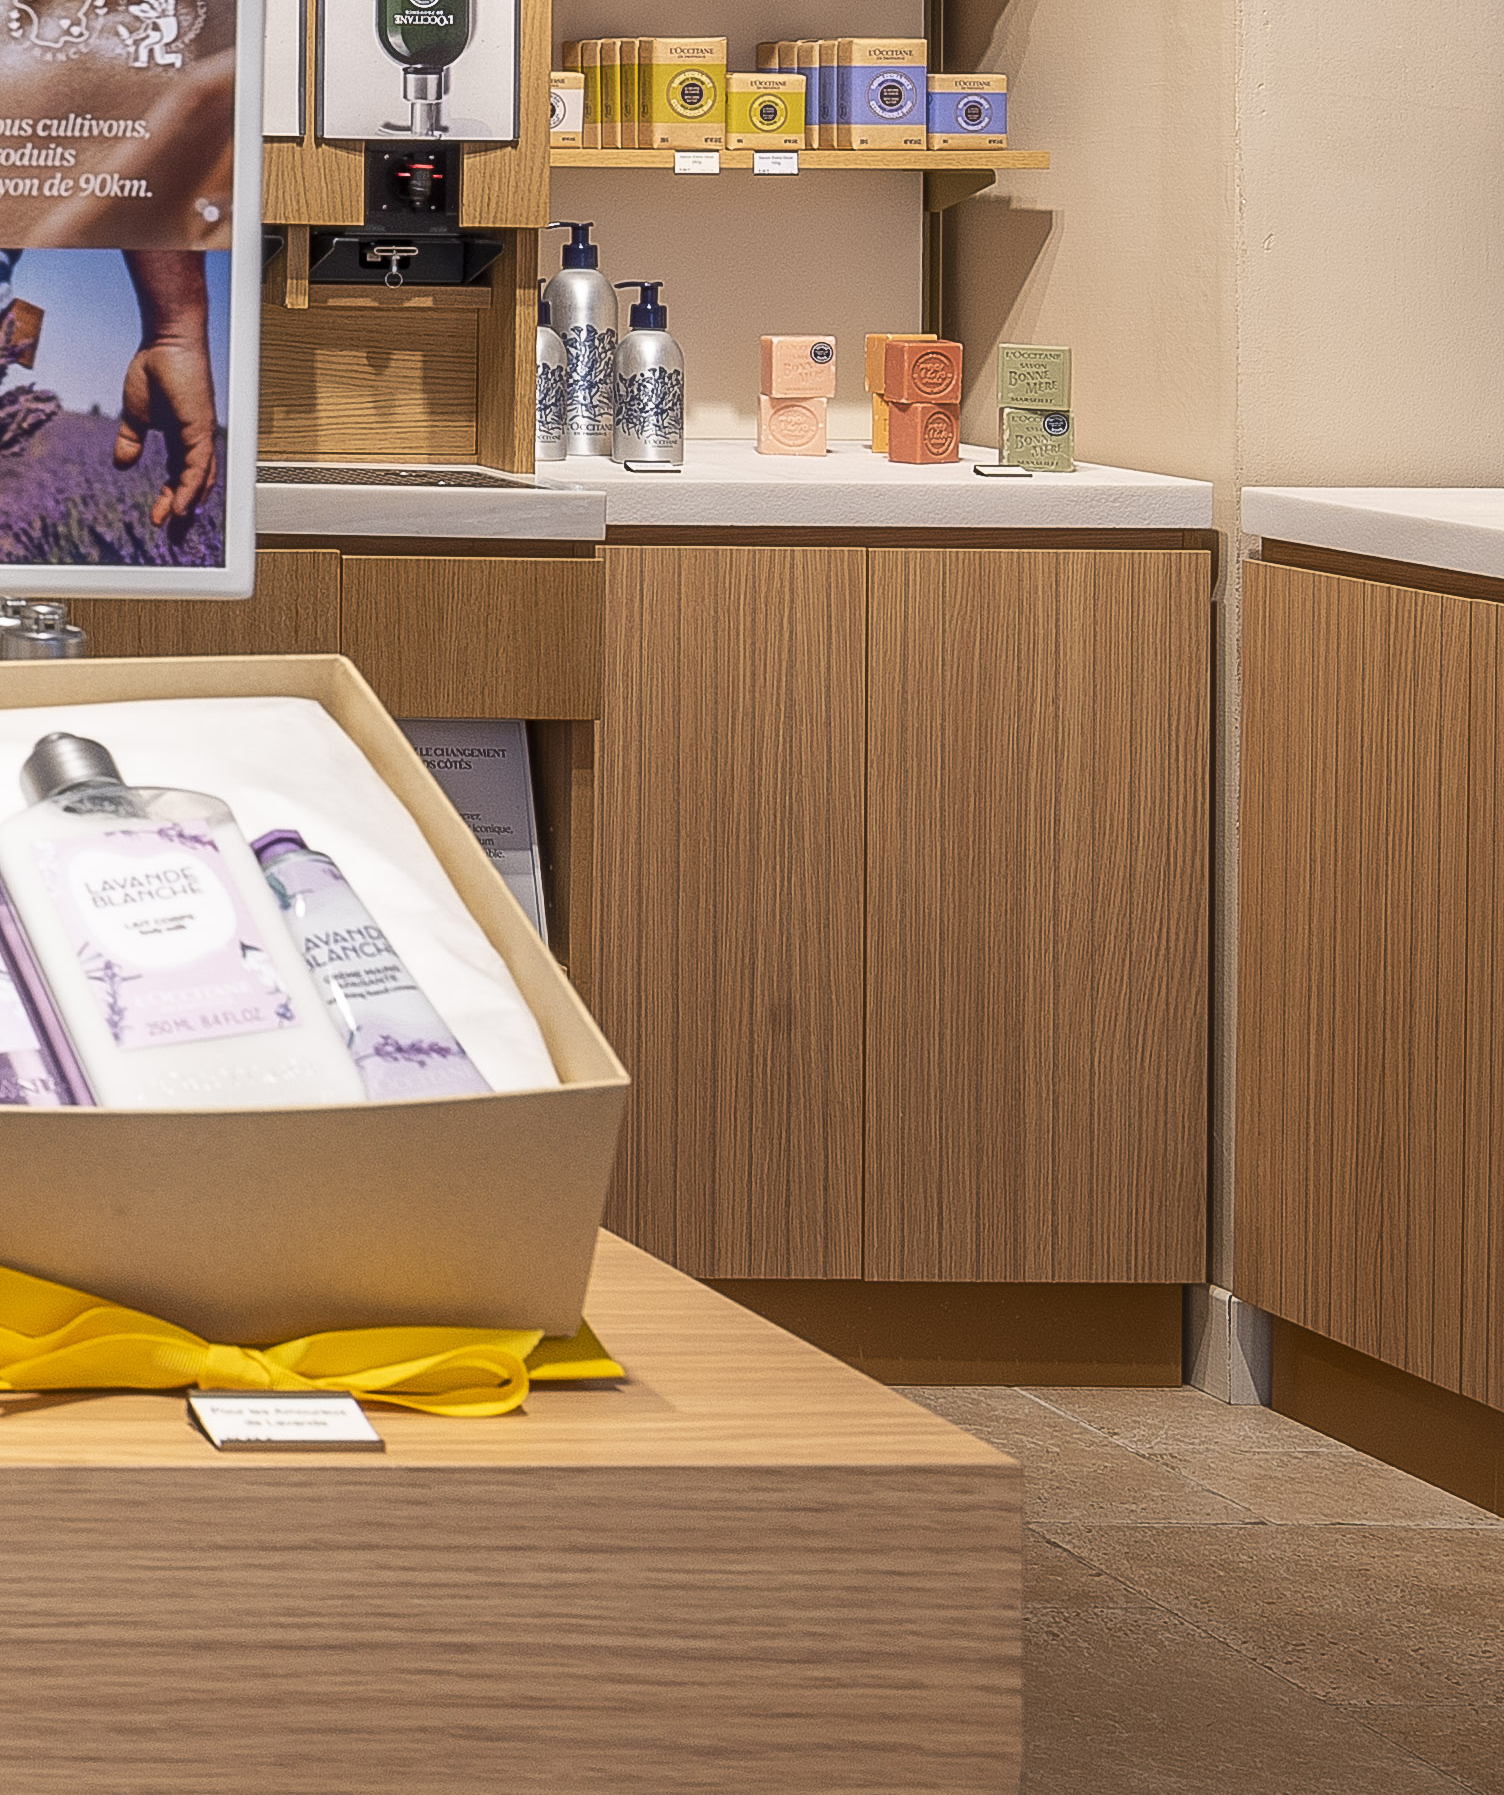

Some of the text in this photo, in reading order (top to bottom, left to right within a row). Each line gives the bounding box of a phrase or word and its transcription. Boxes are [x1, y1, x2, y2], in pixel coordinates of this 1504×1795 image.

[36, 113, 150, 139] cultivons,
[43, 172, 73, 197] de
[79, 173, 153, 197] 90km.
